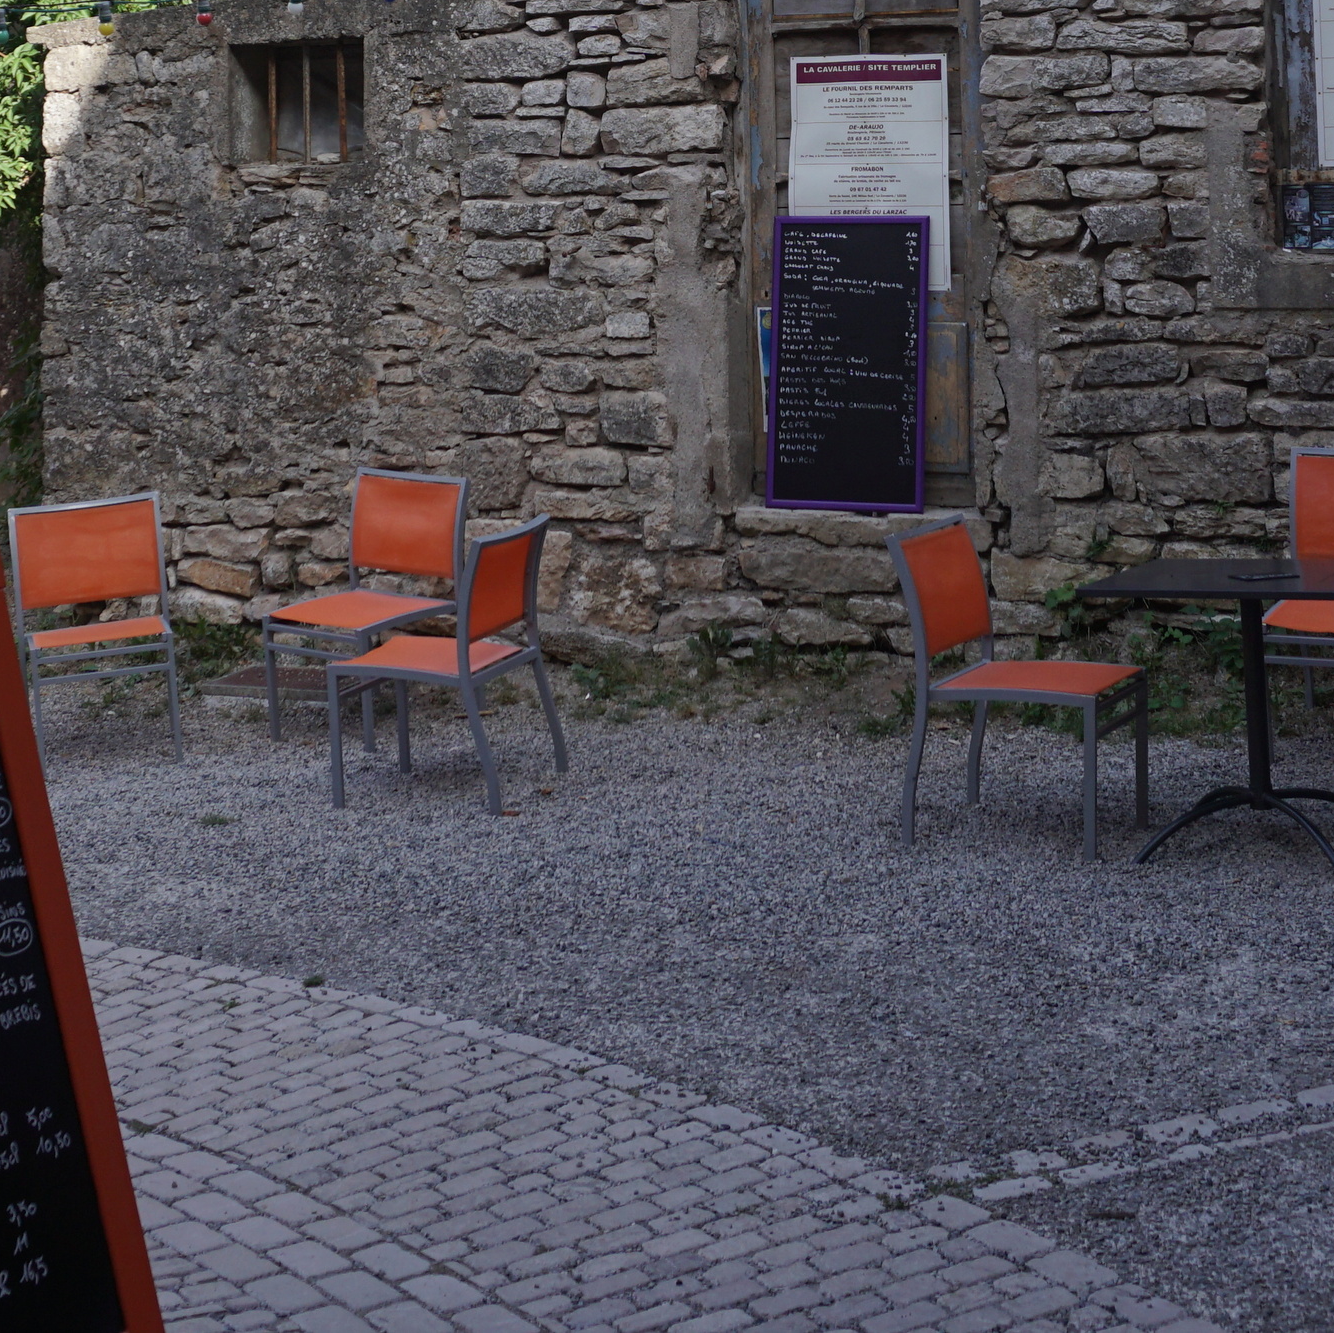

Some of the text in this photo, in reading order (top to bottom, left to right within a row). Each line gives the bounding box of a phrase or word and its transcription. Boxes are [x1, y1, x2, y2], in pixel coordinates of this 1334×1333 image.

[816, 65, 861, 73] CAVALERIE
[891, 63, 937, 71] TEMPLIER
[19, 973, 37, 993] DE
[0, 999, 42, 1030] BREBIS
[36, 1130, 71, 1159] 10,50
[6, 1199, 38, 1228] 3,50
[20, 1254, 49, 1285] 16,5
